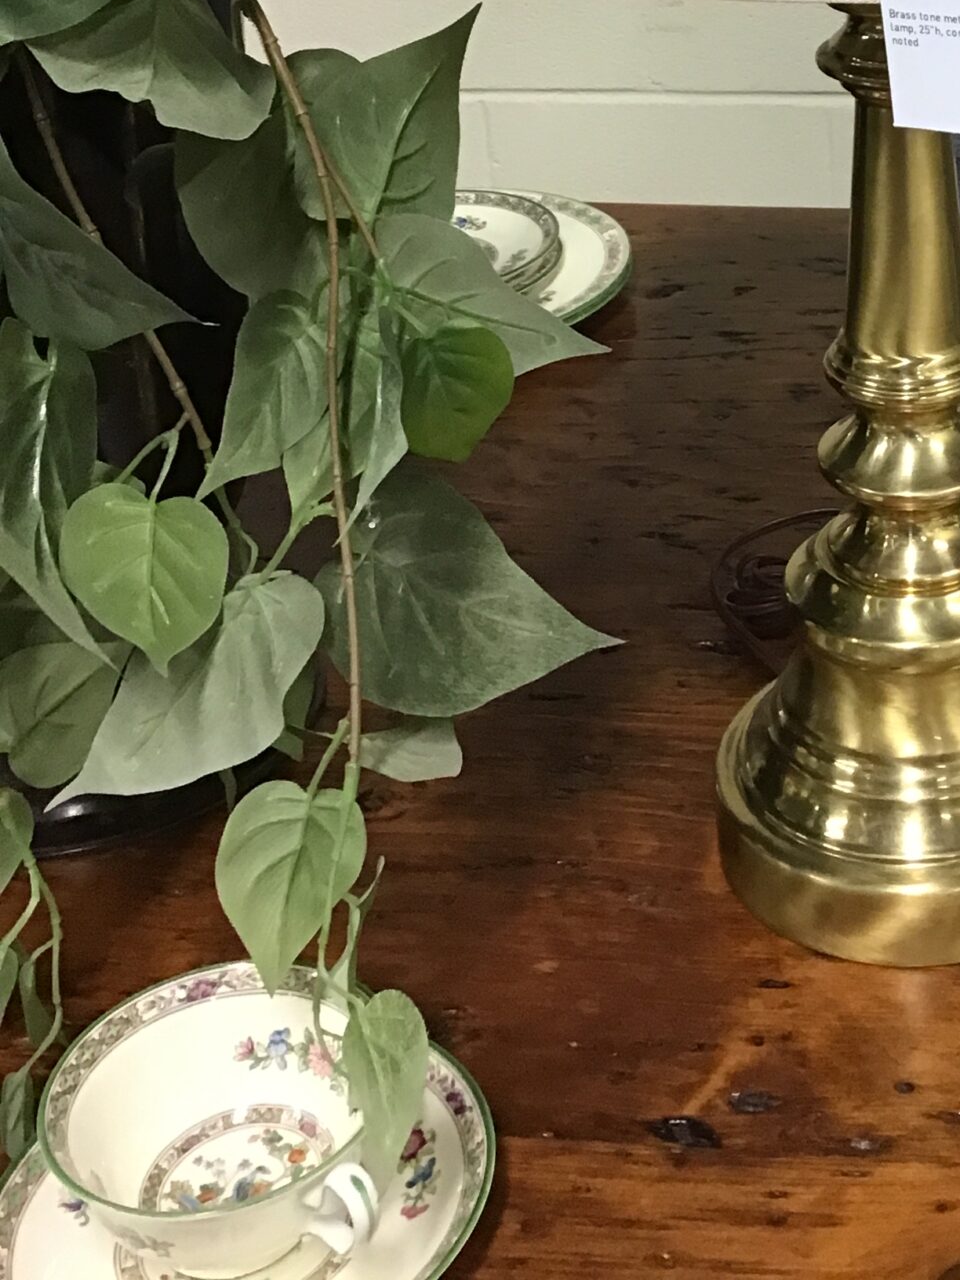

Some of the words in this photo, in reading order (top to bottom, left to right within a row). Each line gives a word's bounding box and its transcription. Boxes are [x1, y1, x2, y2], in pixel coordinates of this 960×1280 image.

[889, 8, 917, 20] Brass
[919, 12, 941, 22] tone
[890, 22, 917, 35] lamp,
[892, 36, 919, 47] noted
